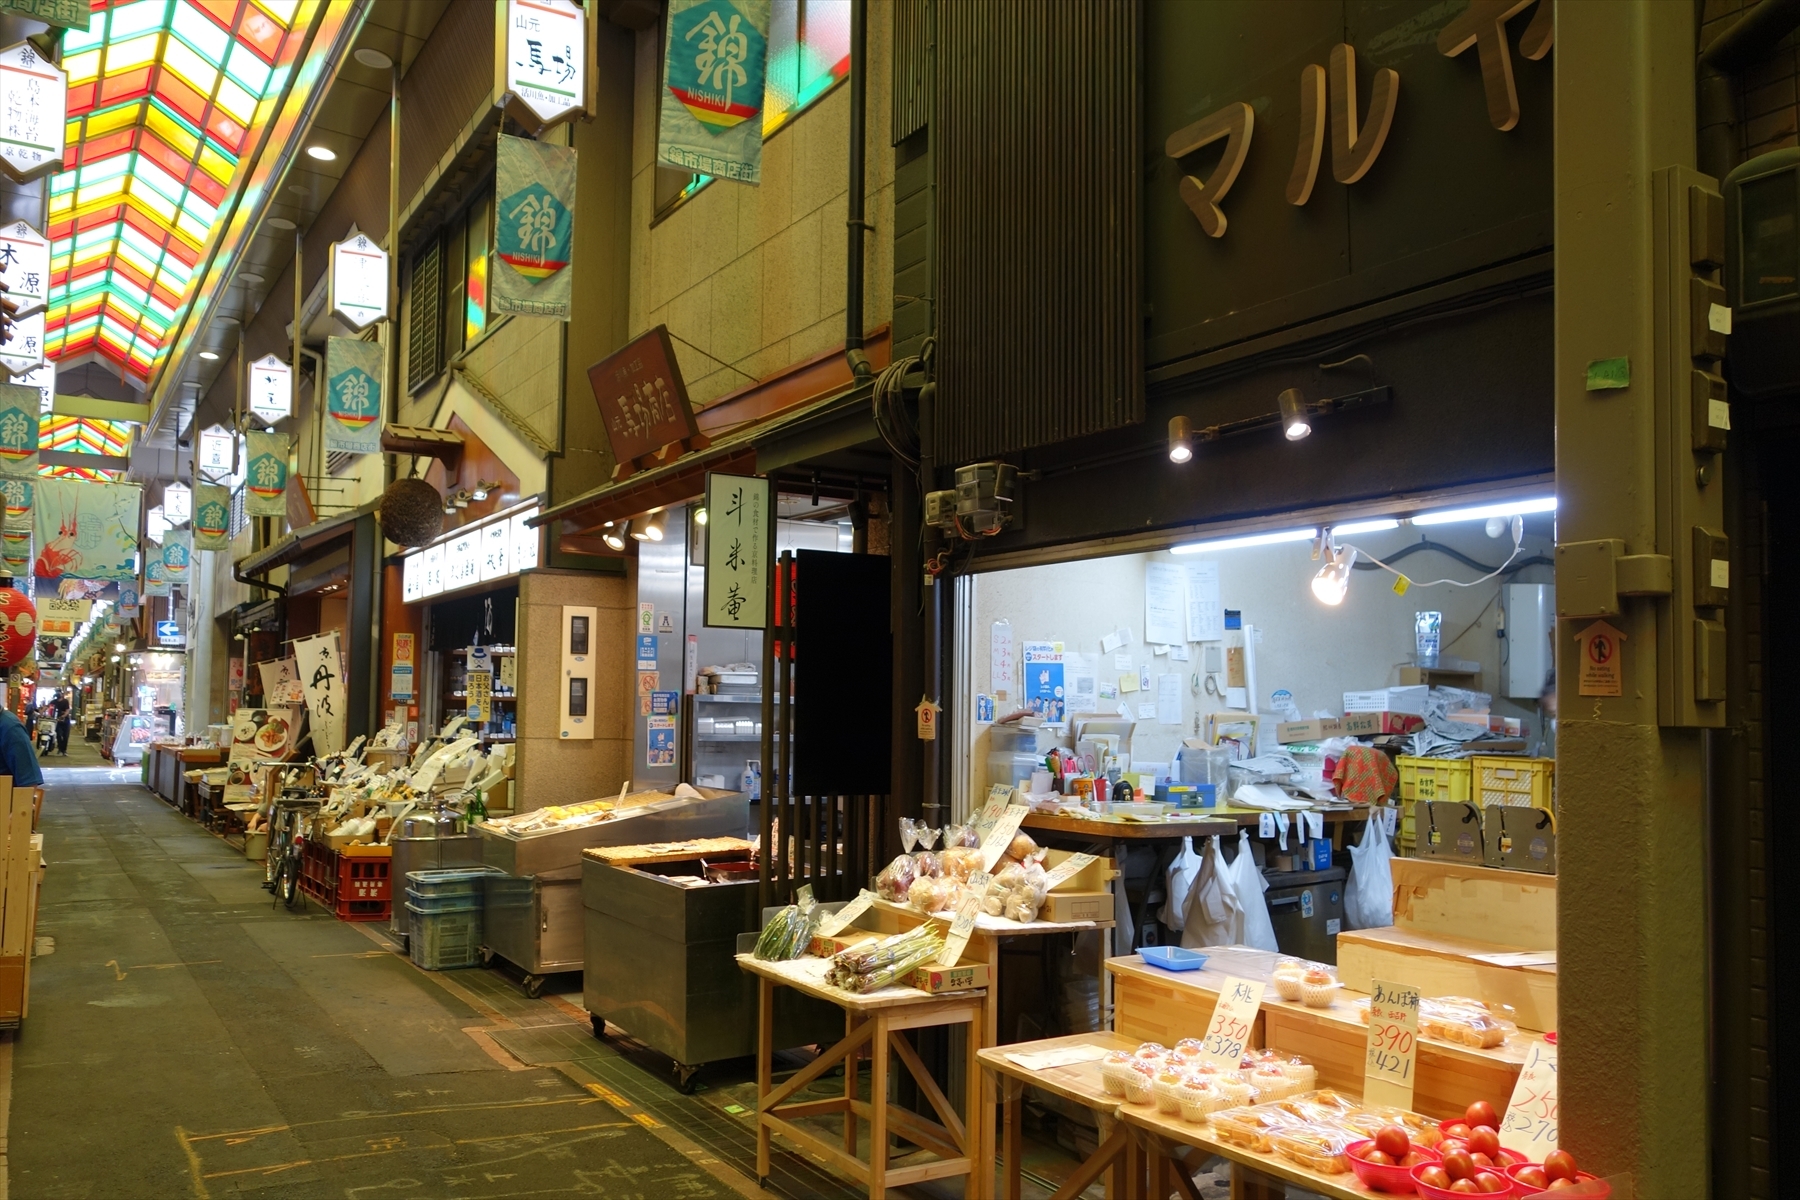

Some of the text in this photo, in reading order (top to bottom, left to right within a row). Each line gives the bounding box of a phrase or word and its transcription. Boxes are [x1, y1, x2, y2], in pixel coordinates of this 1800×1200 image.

[516, 14, 540, 32] 山元
[515, 39, 576, 84] 馬場
[685, 11, 748, 112] 錦
[687, 86, 725, 107] NISHIKI
[668, 146, 753, 183] 錦市場商店街
[508, 194, 556, 267] 錦
[512, 251, 540, 264] NISHIKI
[336, 373, 370, 421] 錦
[0, 413, 29, 453] 錦
[253, 457, 279, 492] 錦
[1032, 653, 1063, 661] スタートします
[475, 674, 483, 706] 日本酒を
[482, 674, 490, 713] お父さんに
[983, 804, 1003, 818] 190
[993, 822, 1015, 836] 150
[957, 898, 980, 921] 190
[1231, 982, 1254, 1003] 桃
[1211, 1014, 1248, 1040] 350
[1371, 1023, 1413, 1054] 390
[1211, 1035, 1242, 1058] 378
[1375, 1050, 1410, 1079] 421
[1515, 1116, 1558, 1143] 270
